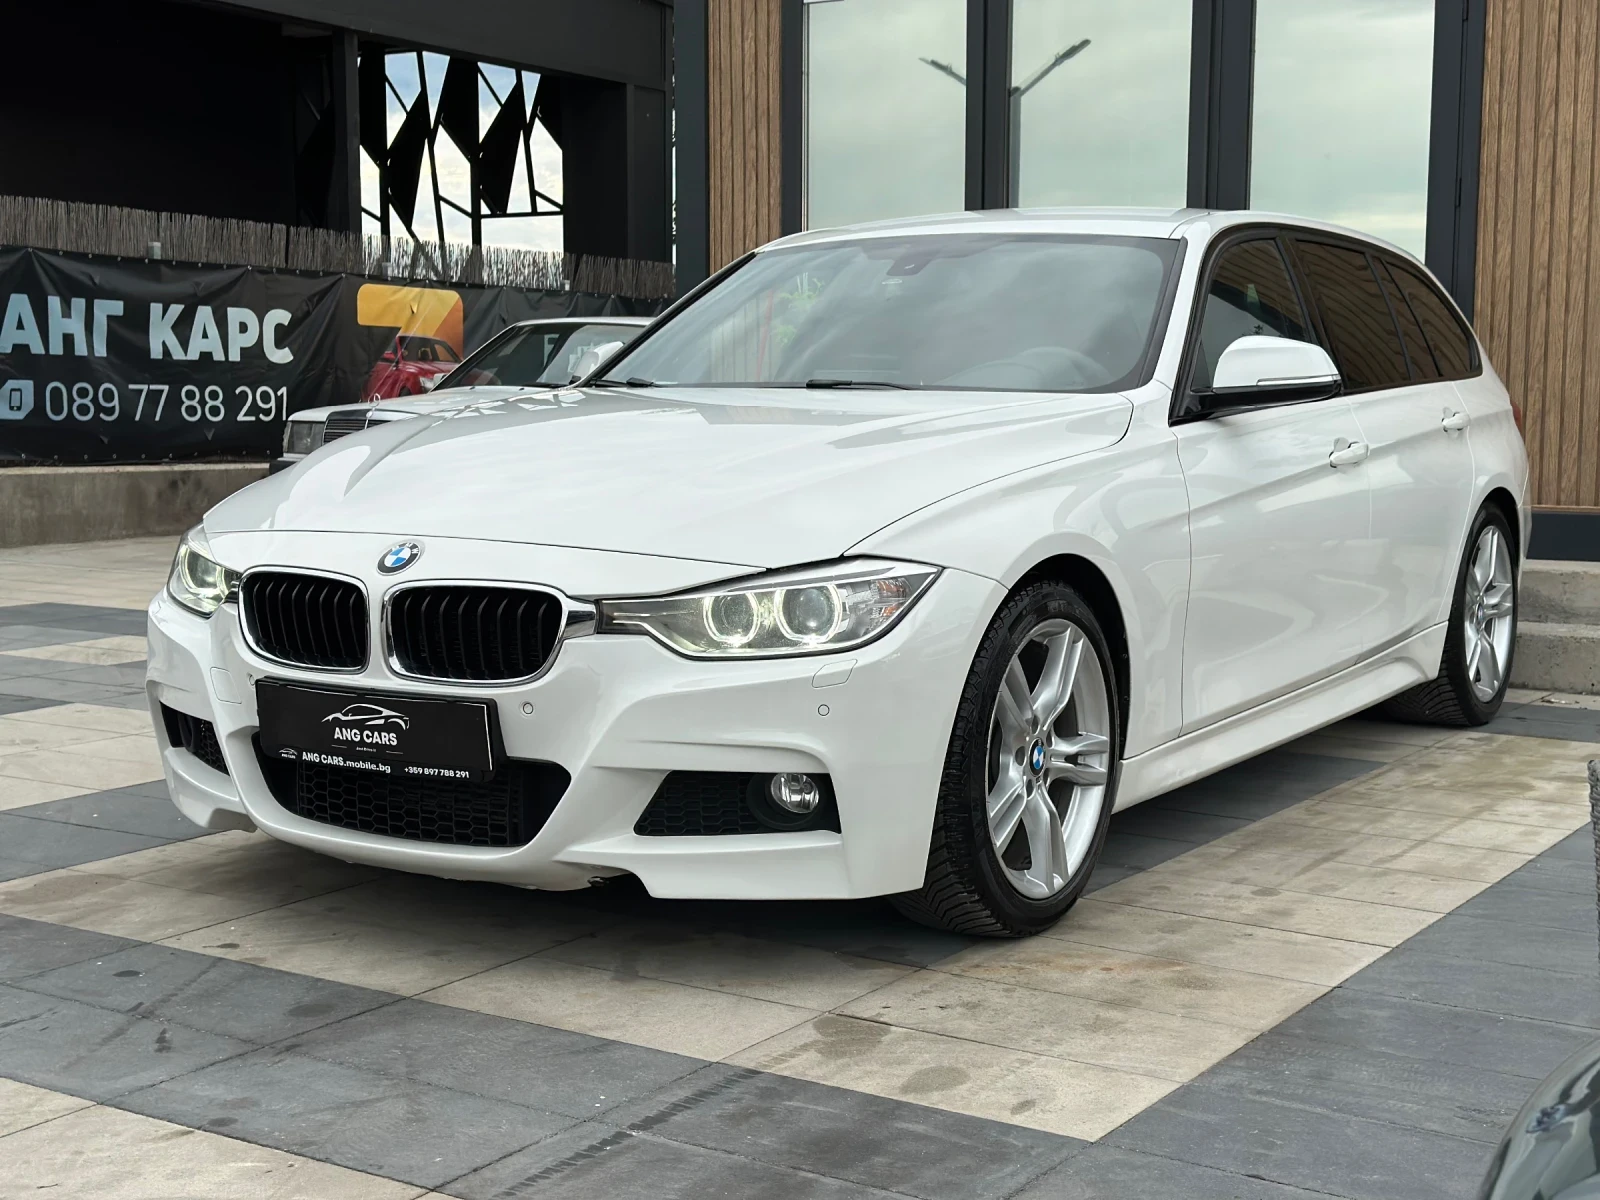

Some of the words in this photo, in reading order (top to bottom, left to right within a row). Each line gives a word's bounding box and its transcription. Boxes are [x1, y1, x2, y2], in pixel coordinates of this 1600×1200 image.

[0, 293, 124, 357] АНГ
[149, 302, 294, 364] КАРС
[45, 381, 120, 421] 089
[128, 384, 169, 421] 77
[181, 385, 225, 422] 88
[235, 385, 288, 422] 291
[333, 726, 361, 742] ANG
[362, 729, 398, 746] CARS
[302, 751, 320, 763] ANG
[320, 754, 391, 774] CARS.mobile.bg
[404, 766, 423, 775] +359
[423, 767, 439, 776] 897
[439, 768, 455, 777] 788
[455, 770, 470, 779] 291
